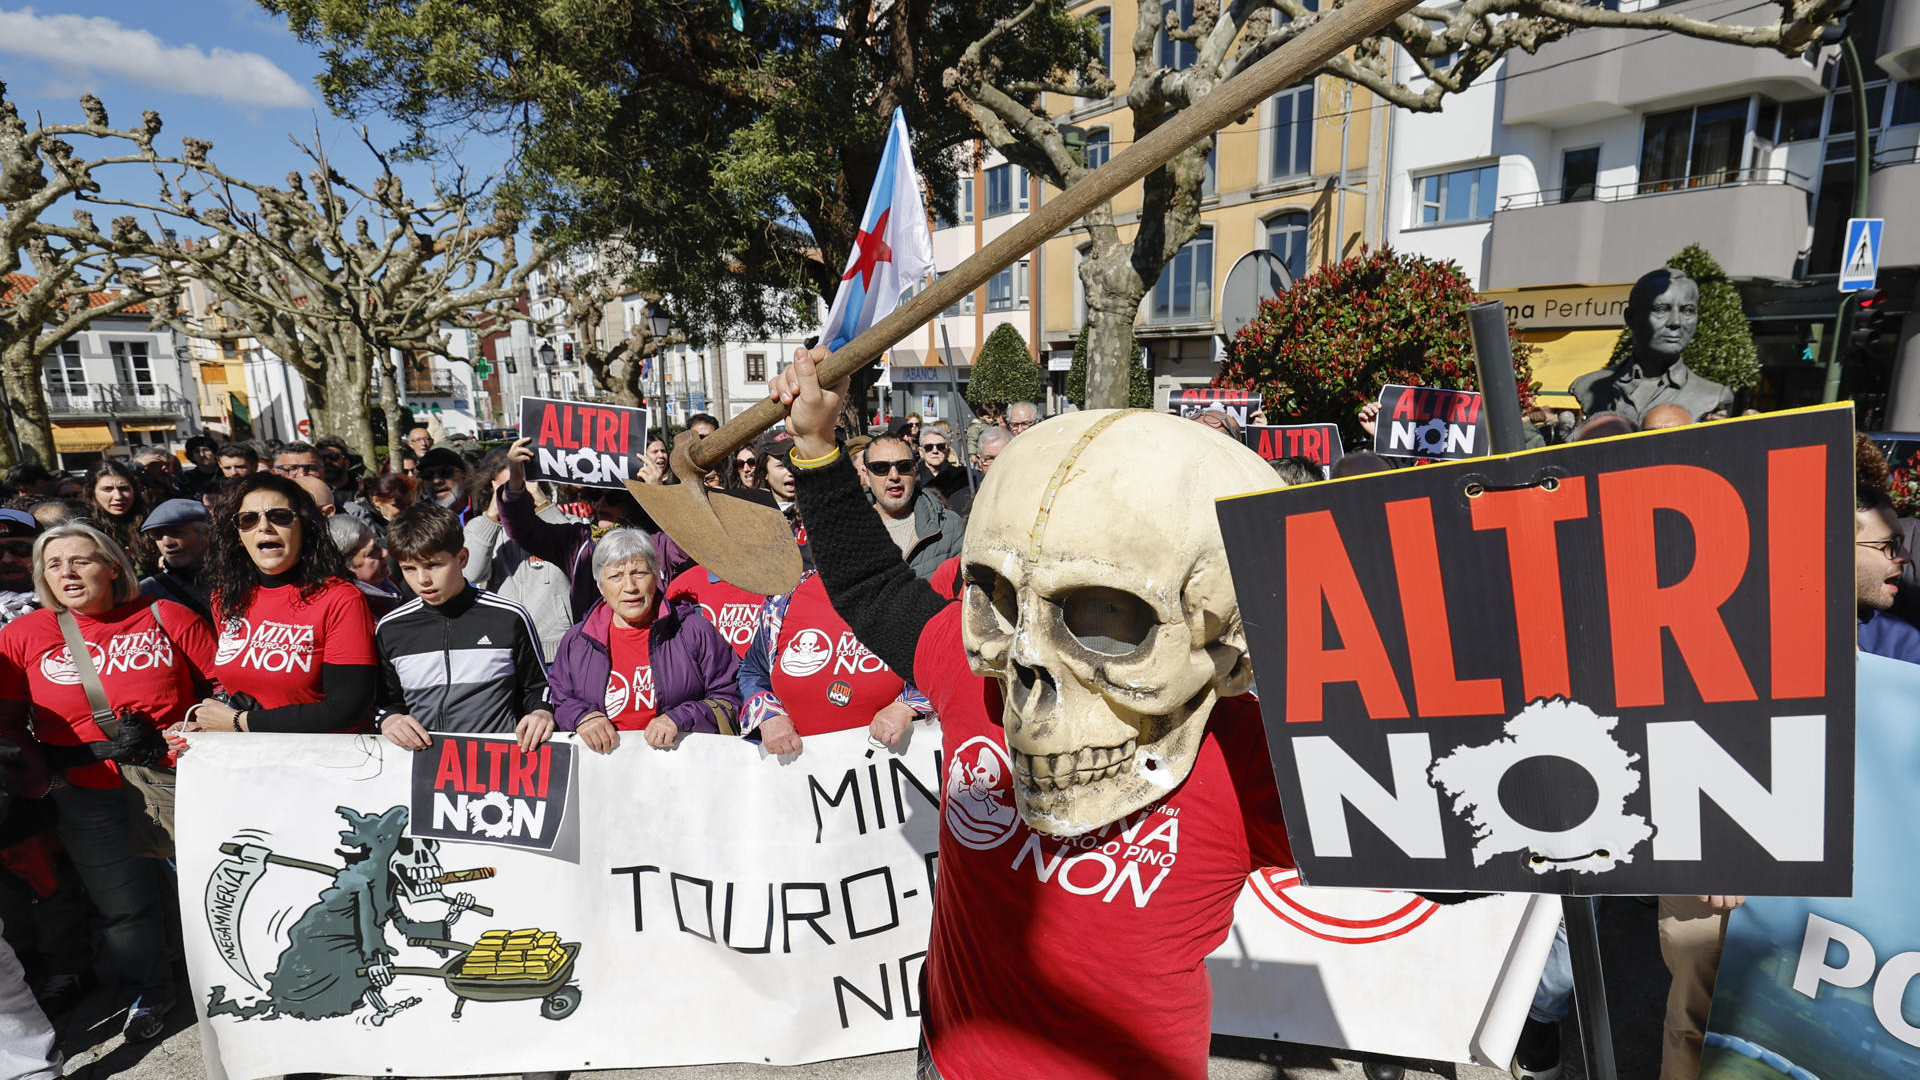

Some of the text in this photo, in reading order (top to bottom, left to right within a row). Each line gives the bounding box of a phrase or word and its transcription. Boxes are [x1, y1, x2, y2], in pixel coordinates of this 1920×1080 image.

[1182, 389, 1248, 405] ALTRI
[1392, 389, 1482, 423] ALTRI
[537, 403, 630, 454] ALTRI
[1389, 418, 1476, 454] NON
[538, 446, 630, 483] NON
[1286, 444, 1826, 723] ALTRI
[719, 607, 760, 621] MIN
[108, 630, 171, 654] MINA
[249, 640, 314, 653] TOURO-O PINO
[251, 624, 314, 645] MINA
[106, 648, 173, 675] NON
[241, 647, 313, 673] NON
[830, 691, 849, 704] NON
[832, 683, 851, 696] ALTRI
[433, 738, 552, 798] ALTRI
[1291, 697, 1826, 874] NON
[432, 790, 547, 838] NON
[1010, 832, 1172, 908] NON
[1122, 845, 1177, 868] PINO
